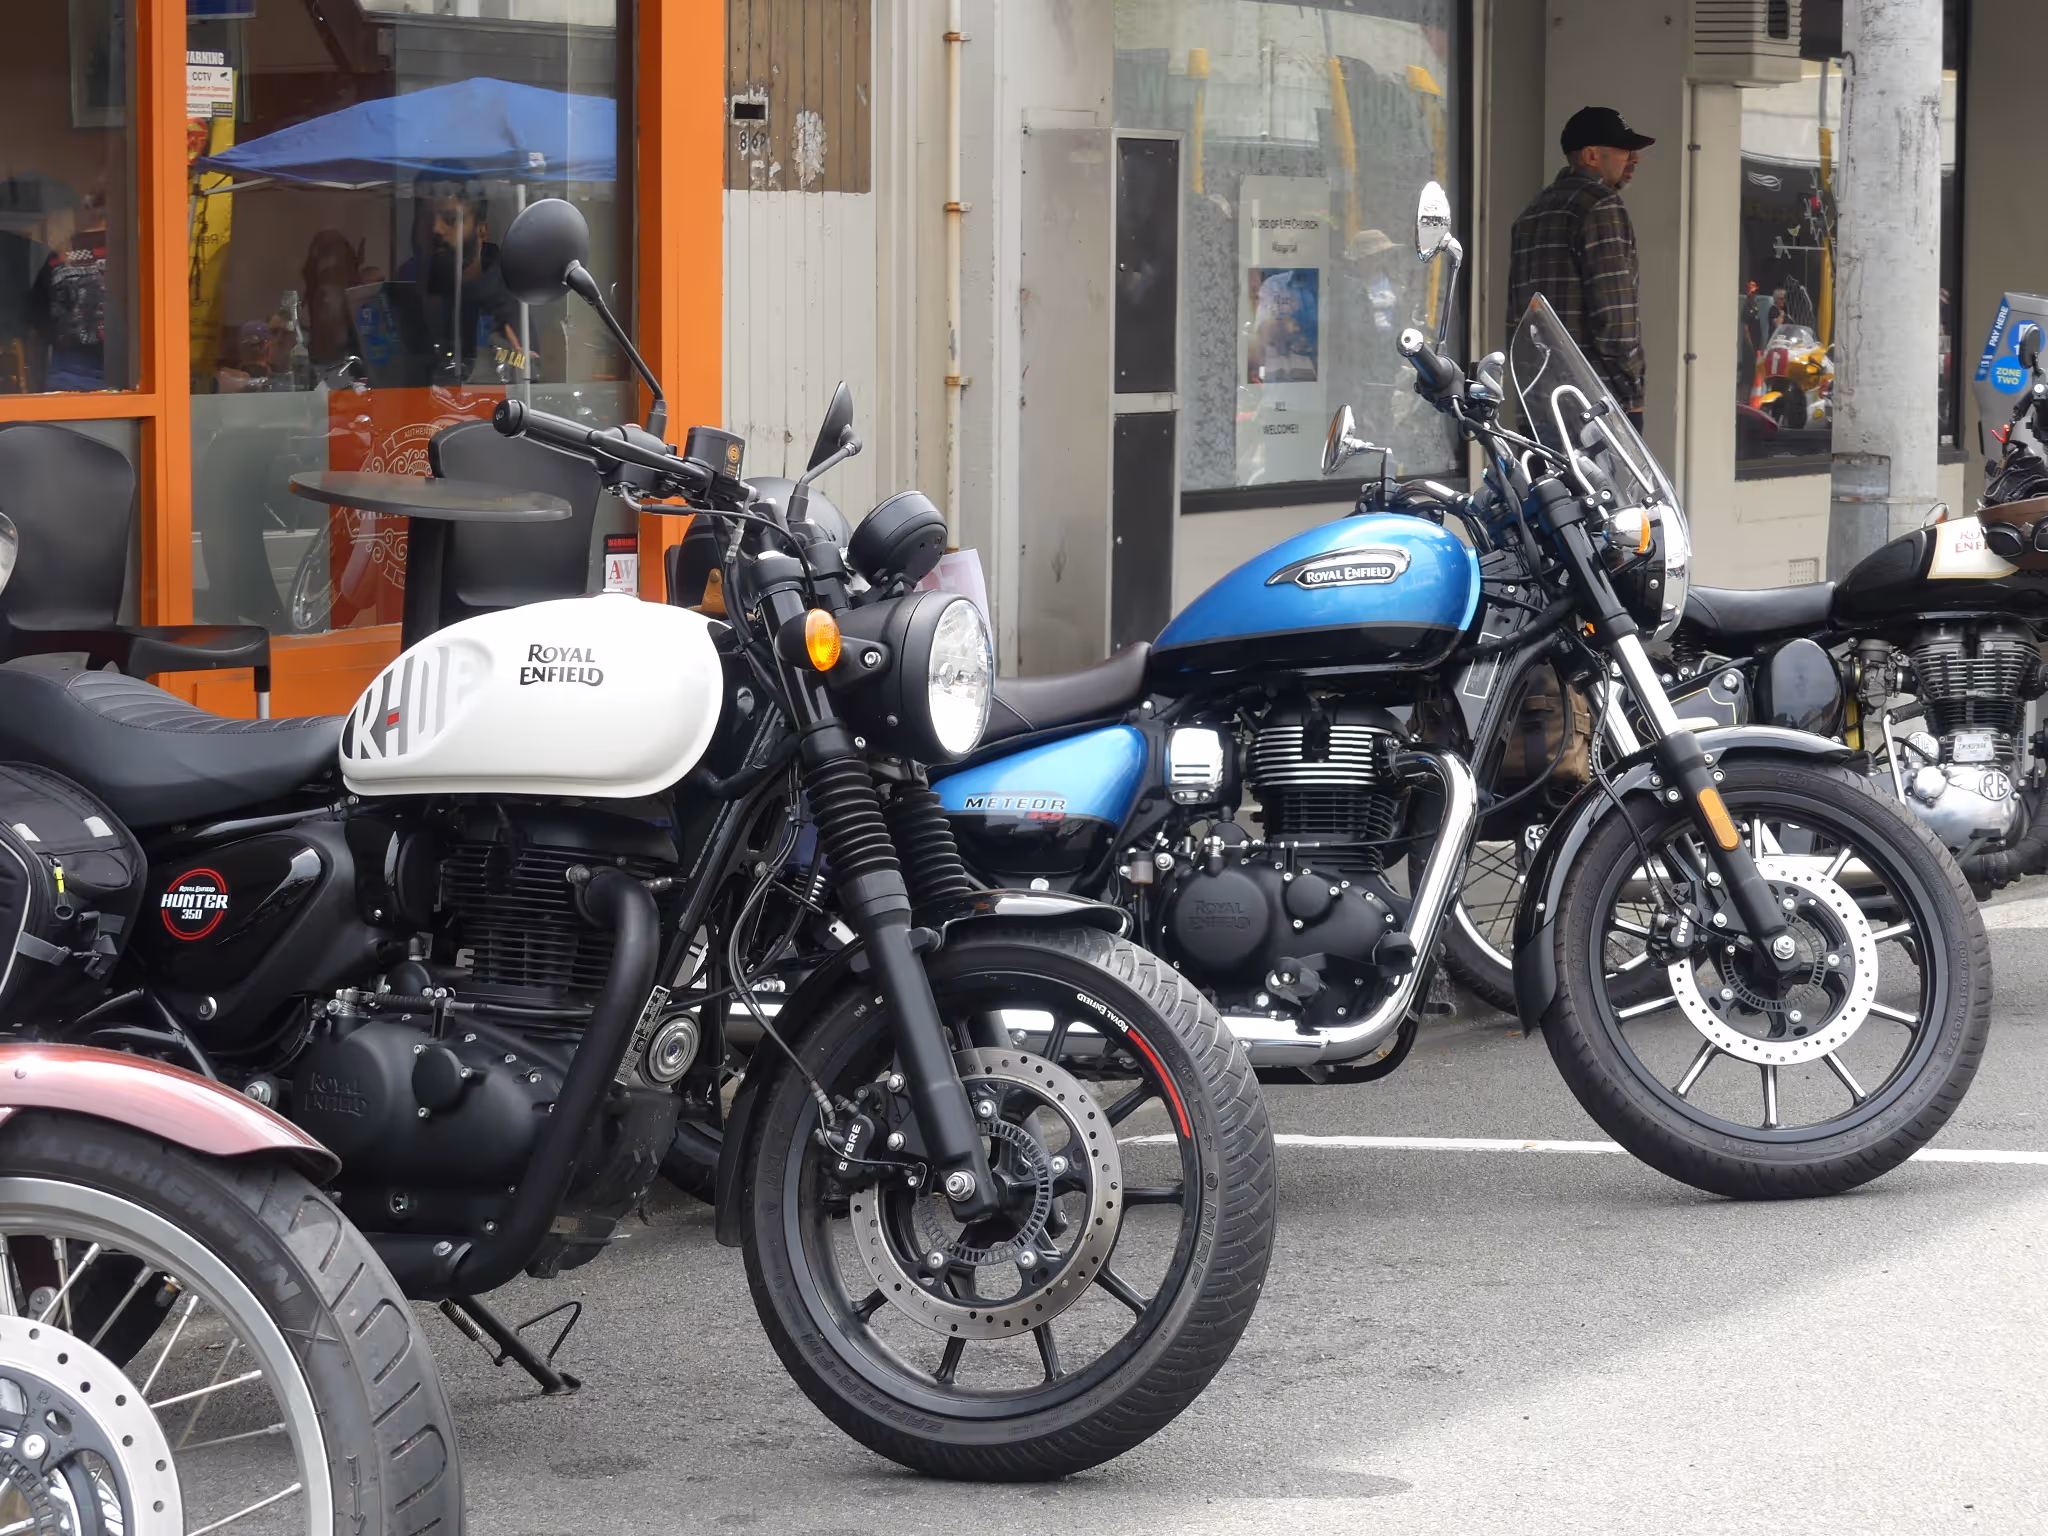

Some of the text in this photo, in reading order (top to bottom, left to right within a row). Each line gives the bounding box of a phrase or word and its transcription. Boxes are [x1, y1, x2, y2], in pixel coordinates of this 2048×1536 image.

[192, 71, 211, 81] CCTV
[1989, 305, 2009, 347] PAY HERE
[1996, 367, 2022, 377] ZONE
[1997, 376, 2019, 385] TWO
[1306, 566, 1392, 583] ROYAL ENFIELD
[528, 644, 596, 664] ROYAL
[520, 667, 604, 687] ENFIELD
[1983, 772, 2008, 799] RE
[965, 798, 1066, 811] METEOR
[1026, 811, 1065, 820] 350
[161, 894, 229, 909] HUNTER
[181, 909, 203, 919] 350
[1076, 993, 1129, 1033] ROYAL ENFIELD
[1190, 1201, 1217, 1290] MRF
